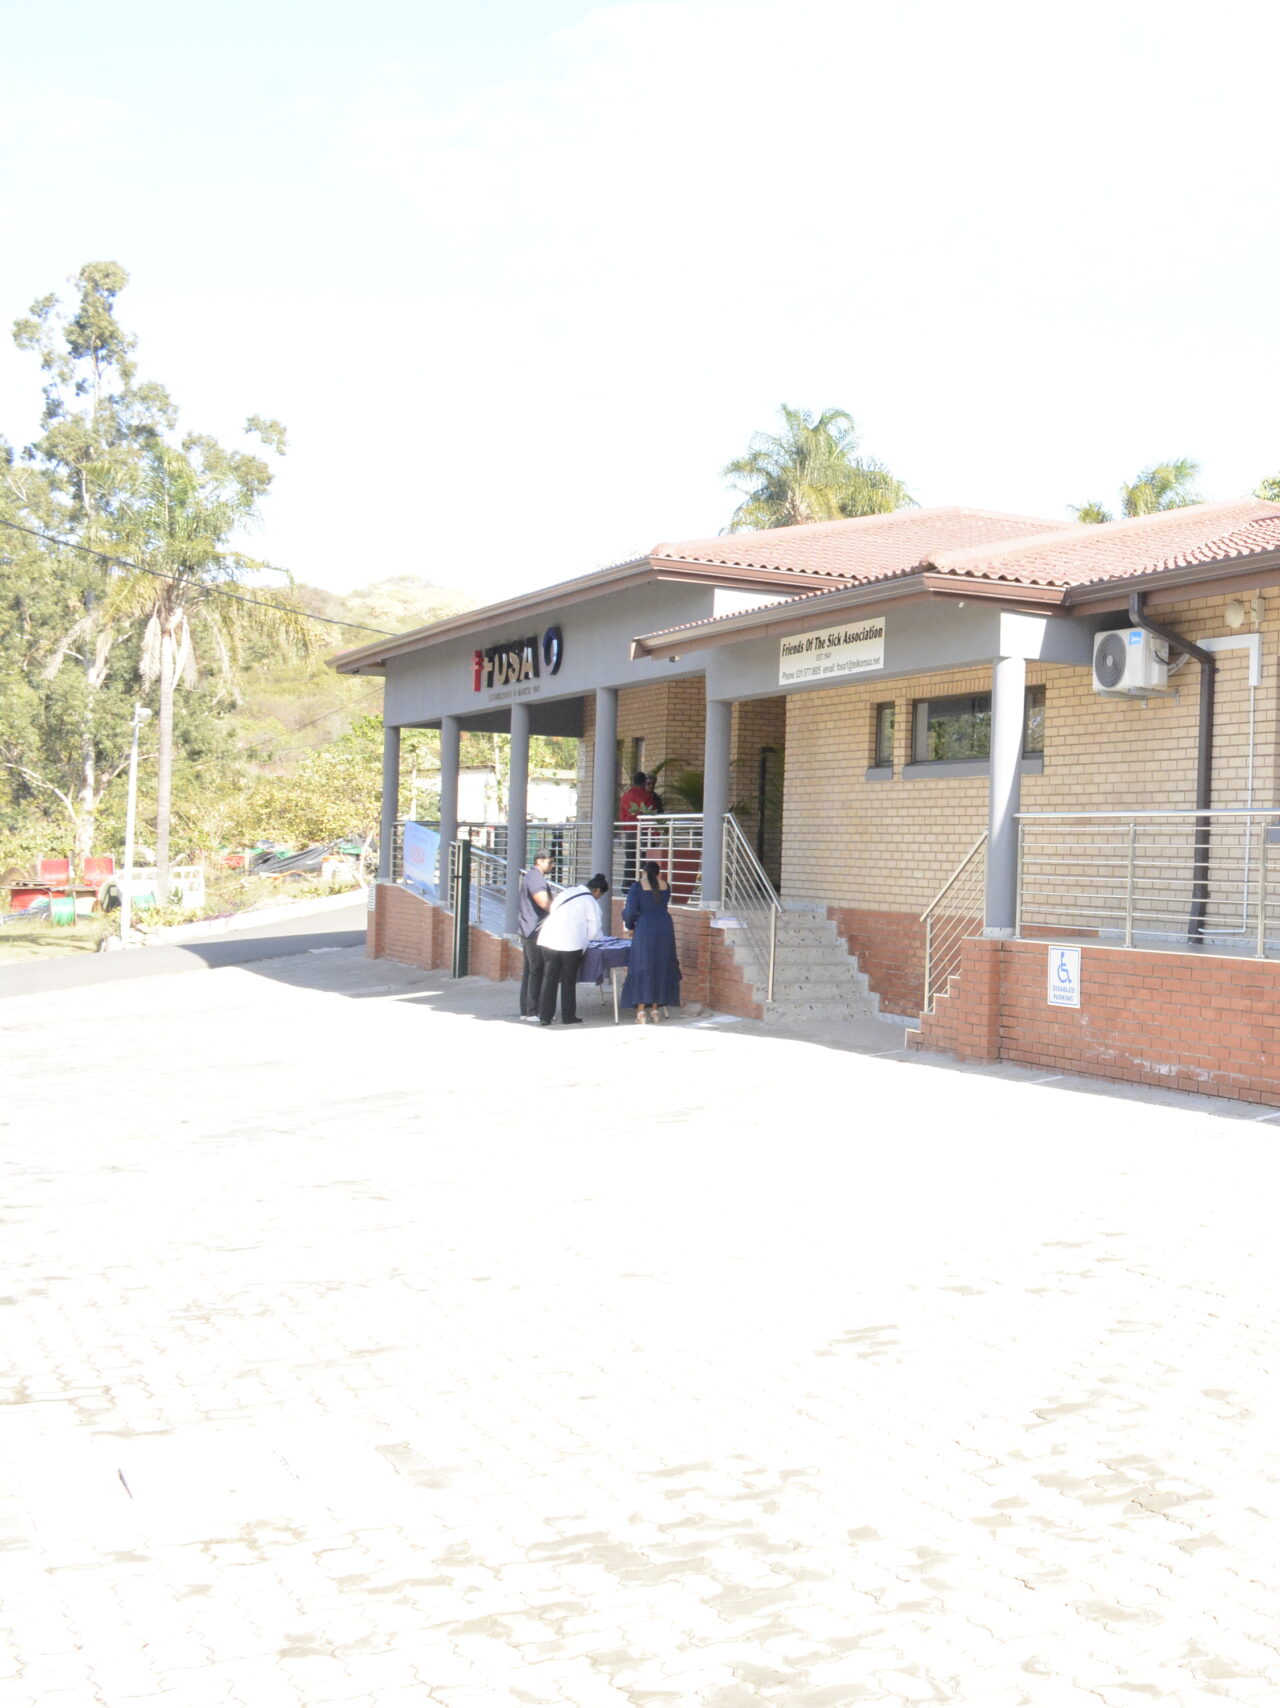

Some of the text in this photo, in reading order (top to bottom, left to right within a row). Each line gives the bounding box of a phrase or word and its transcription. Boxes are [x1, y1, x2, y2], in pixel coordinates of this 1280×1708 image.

[781, 625, 883, 657] Friends Of The Sick Association
